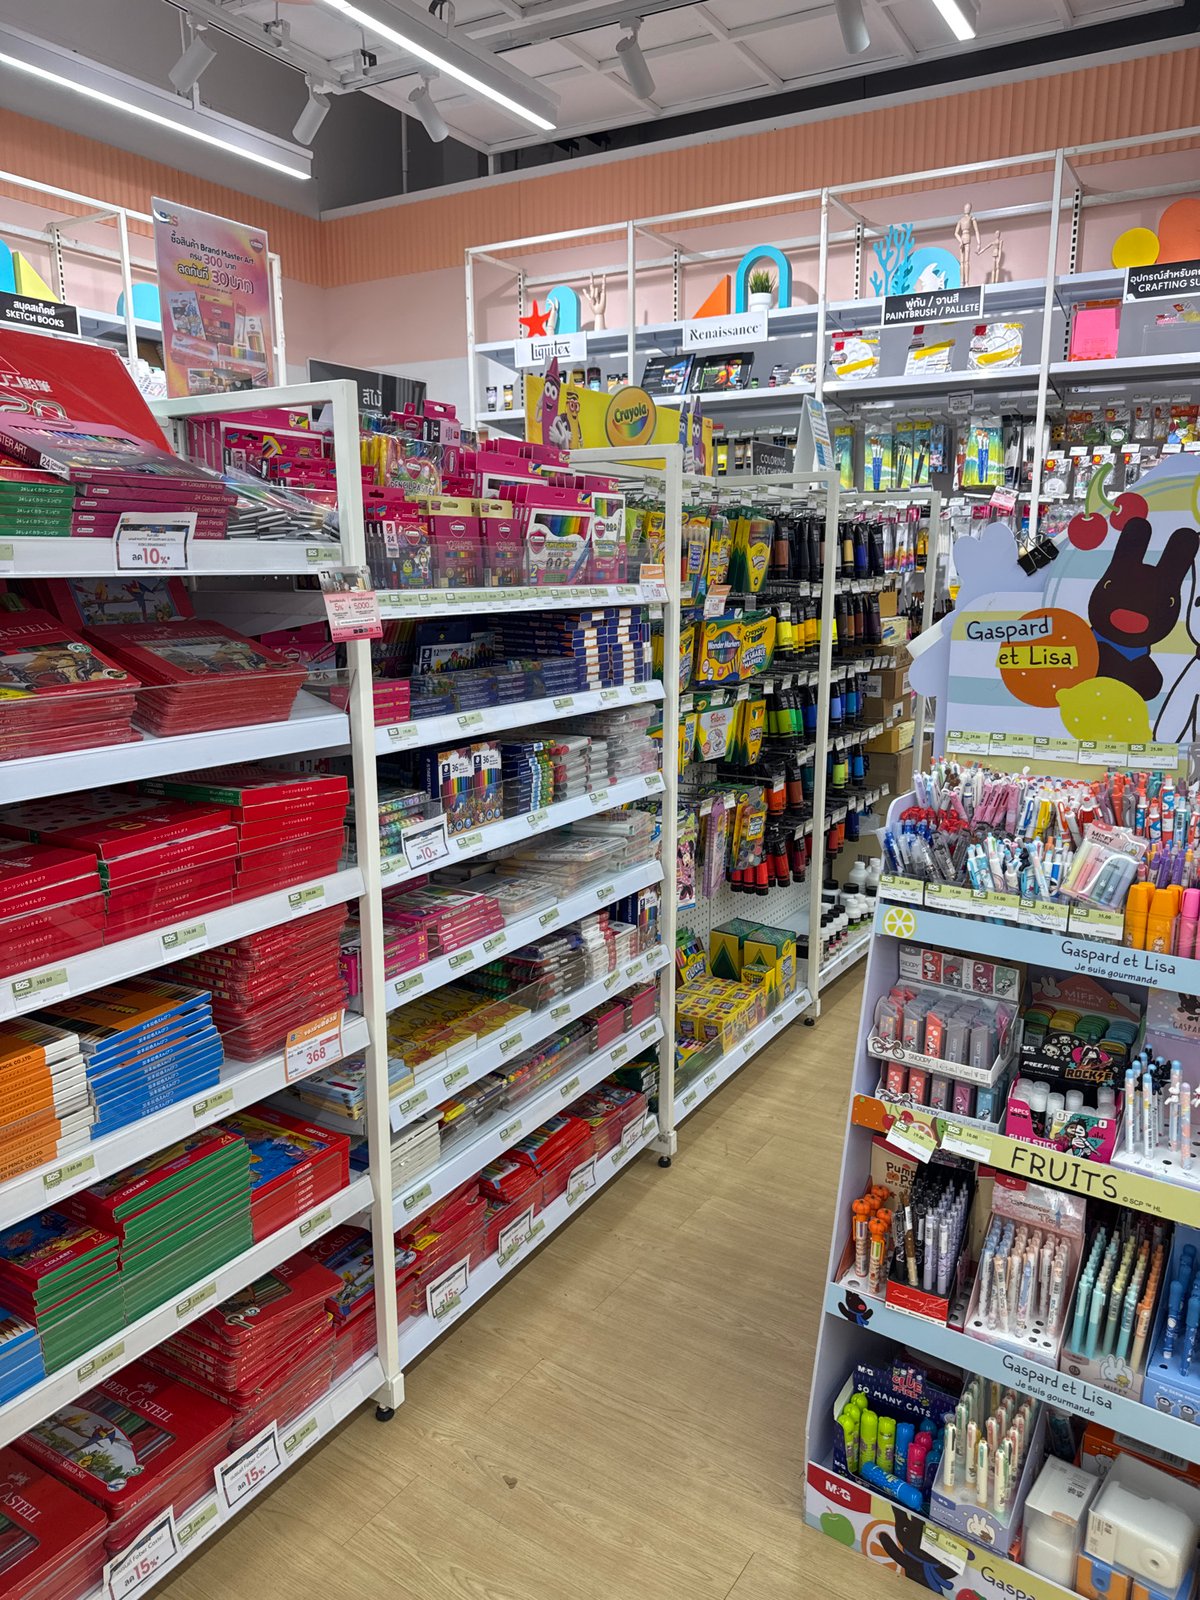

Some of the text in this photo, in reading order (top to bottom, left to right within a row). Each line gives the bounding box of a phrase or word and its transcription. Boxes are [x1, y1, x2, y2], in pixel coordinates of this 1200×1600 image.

[200, 243, 220, 256] Brand
[221, 249, 243, 262] Master
[203, 253, 223, 268] 300
[1138, 279, 1188, 293] CRAFTING
[905, 297, 926, 311] พู่กัน
[936, 292, 960, 305] จานสี
[5, 308, 65, 328] SKETCH BOOKS
[885, 307, 937, 321] PAINTBRUSH
[945, 302, 980, 314] PALLETE
[689, 324, 759, 341] Renaissance
[531, 340, 571, 361] Liquitex
[613, 401, 648, 424] Crayola
[14, 442, 27, 456] ART
[41, 455, 51, 469] 24
[760, 453, 786, 467] COLORING
[0, 622, 58, 638] ASTELL
[966, 614, 1050, 645] Gaspard
[999, 645, 1073, 666] et Lisa
[1061, 940, 1176, 975] Gaspard et Lisa
[1074, 963, 1158, 985] Je suis gourmande
[306, 1047, 327, 1066] 368
[1023, 1060, 1042, 1070] FREE
[1009, 1106, 1030, 1117] 24PCS
[1032, 1138, 1059, 1151] STICK
[1010, 1146, 1118, 1199] FRUITS
[122, 1179, 149, 1197] COLLEEN
[1002, 1354, 1113, 1410] Gaspard et Lisa
[102, 1378, 174, 1424] ABER-CASTELL
[857, 1384, 932, 1418] SO MANY CATS
[1015, 1379, 1096, 1417] Je suis gourmande
[825, 1479, 852, 1502] M&G
